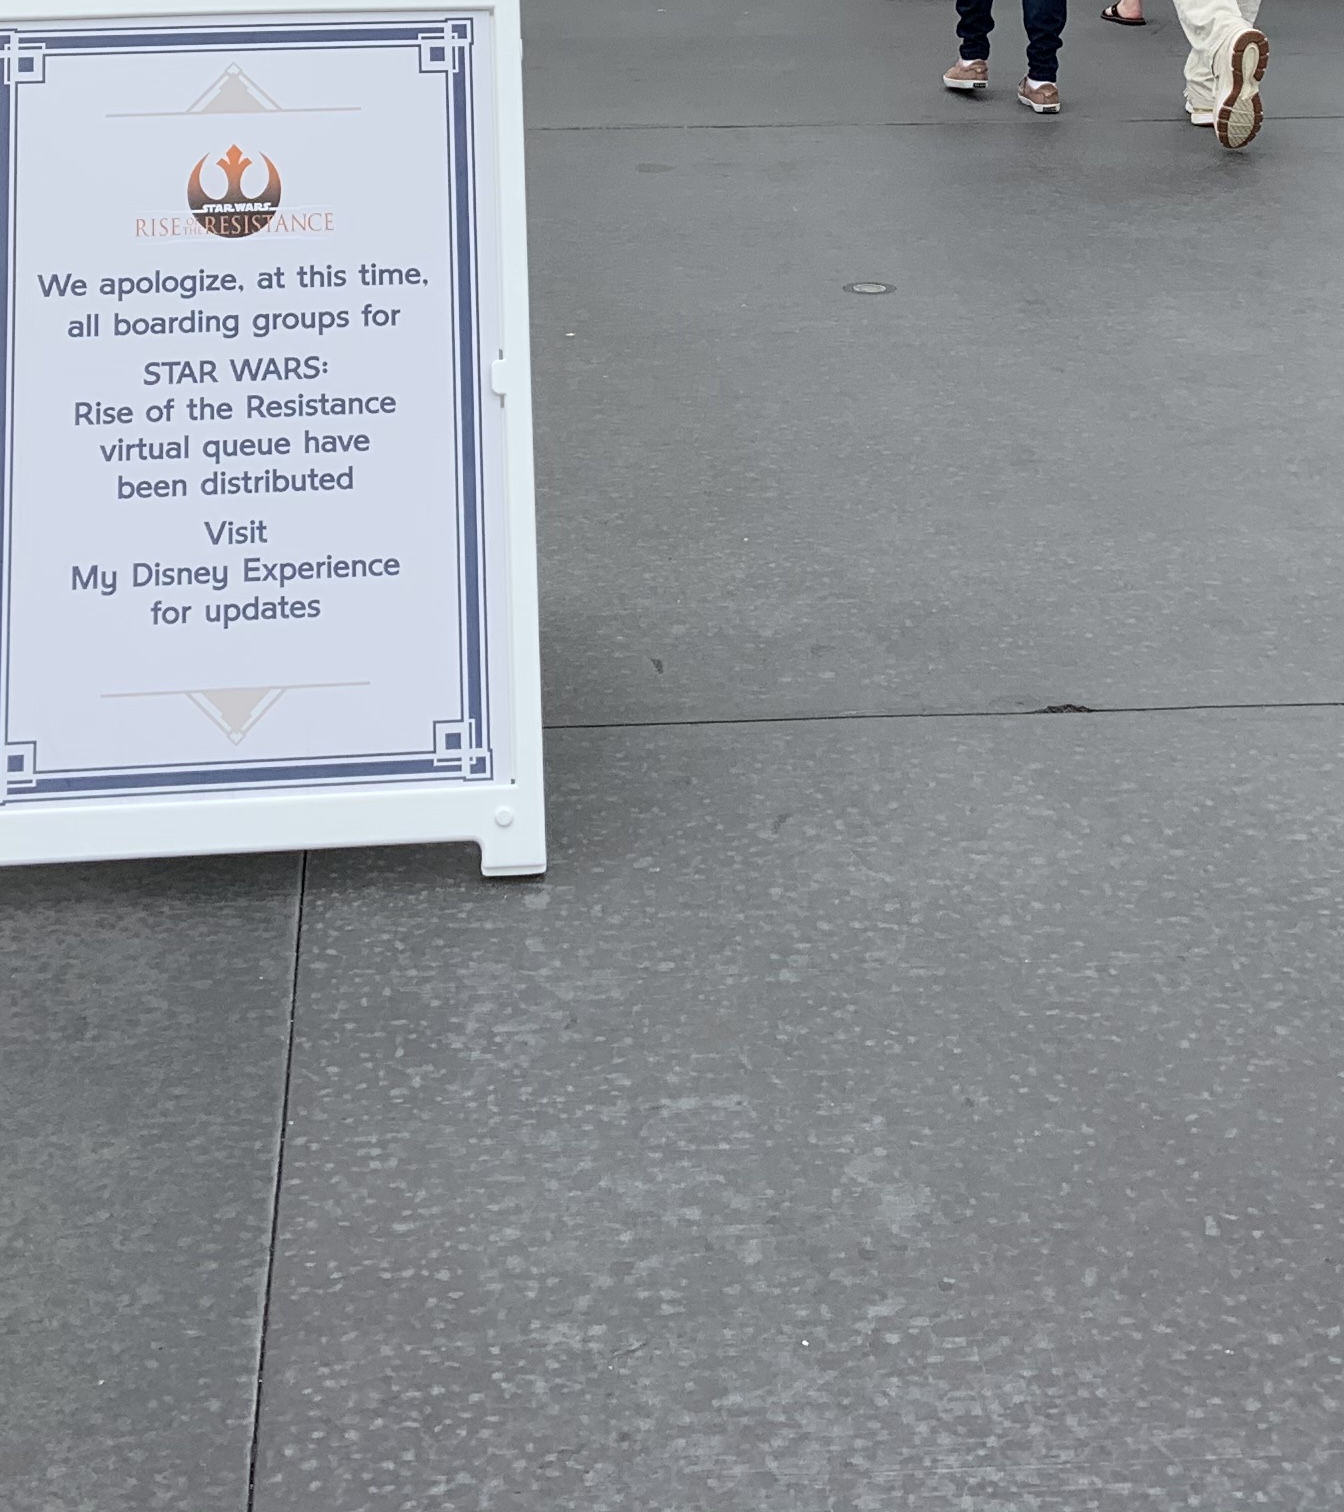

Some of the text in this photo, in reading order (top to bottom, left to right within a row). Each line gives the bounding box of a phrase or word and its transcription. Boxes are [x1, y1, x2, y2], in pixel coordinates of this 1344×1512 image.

[202, 202, 272, 213] STAR WARS
[136, 217, 181, 237] RISE
[205, 212, 335, 236] RESISTANCE
[38, 263, 429, 301] We apologize, at this time,
[68, 304, 400, 338] all boarding groups for
[144, 356, 328, 385] STAR WARS:
[75, 393, 396, 425] Rise of the Resistance
[100, 430, 370, 464] virtual queue have
[118, 466, 353, 499] been distributed
[204, 520, 267, 545] Visit
[72, 555, 400, 596] My Disney Experience
[151, 596, 320, 629] for updates
